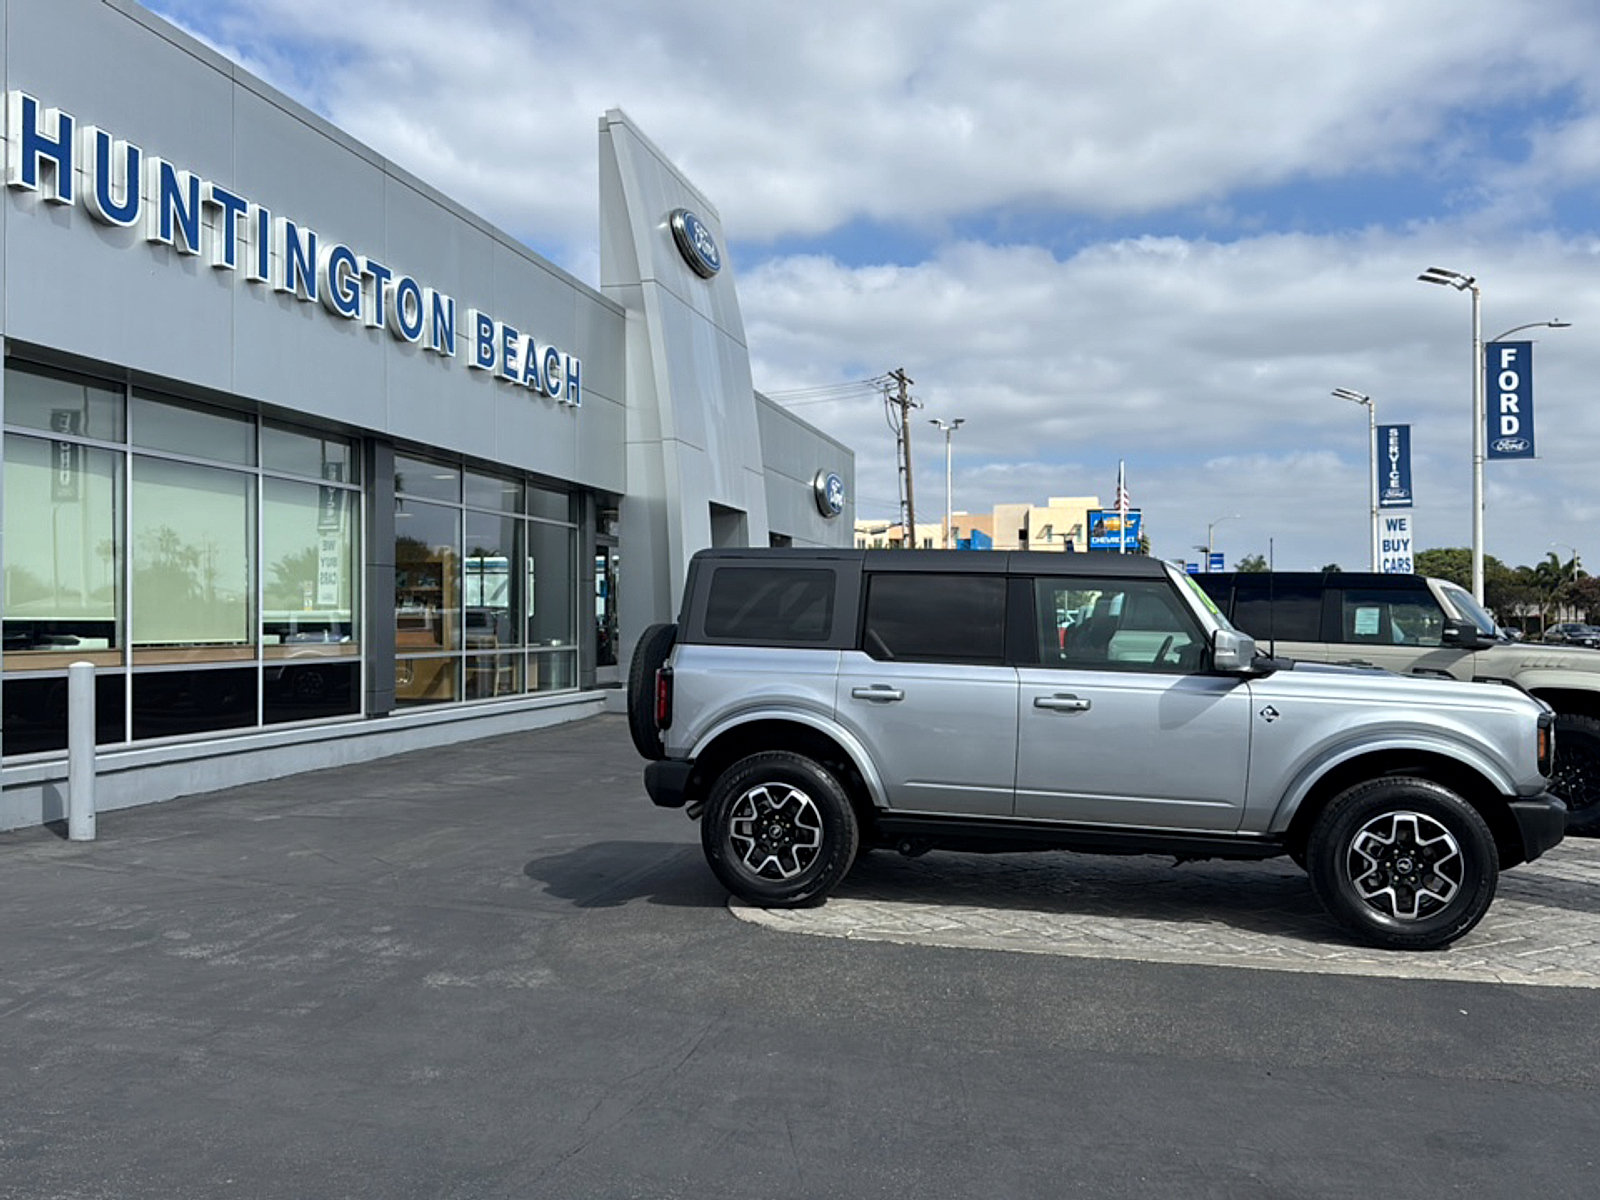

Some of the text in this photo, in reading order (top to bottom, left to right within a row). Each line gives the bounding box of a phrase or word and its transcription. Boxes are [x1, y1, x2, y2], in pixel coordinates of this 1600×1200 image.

[10, 91, 581, 406] HUNTINGTON BEACH
[1498, 348, 1520, 436] FORD
[1388, 427, 1401, 488] SERVICE
[1386, 518, 1407, 532] WE
[1382, 538, 1410, 553] BUY
[1383, 558, 1412, 572] CARS
